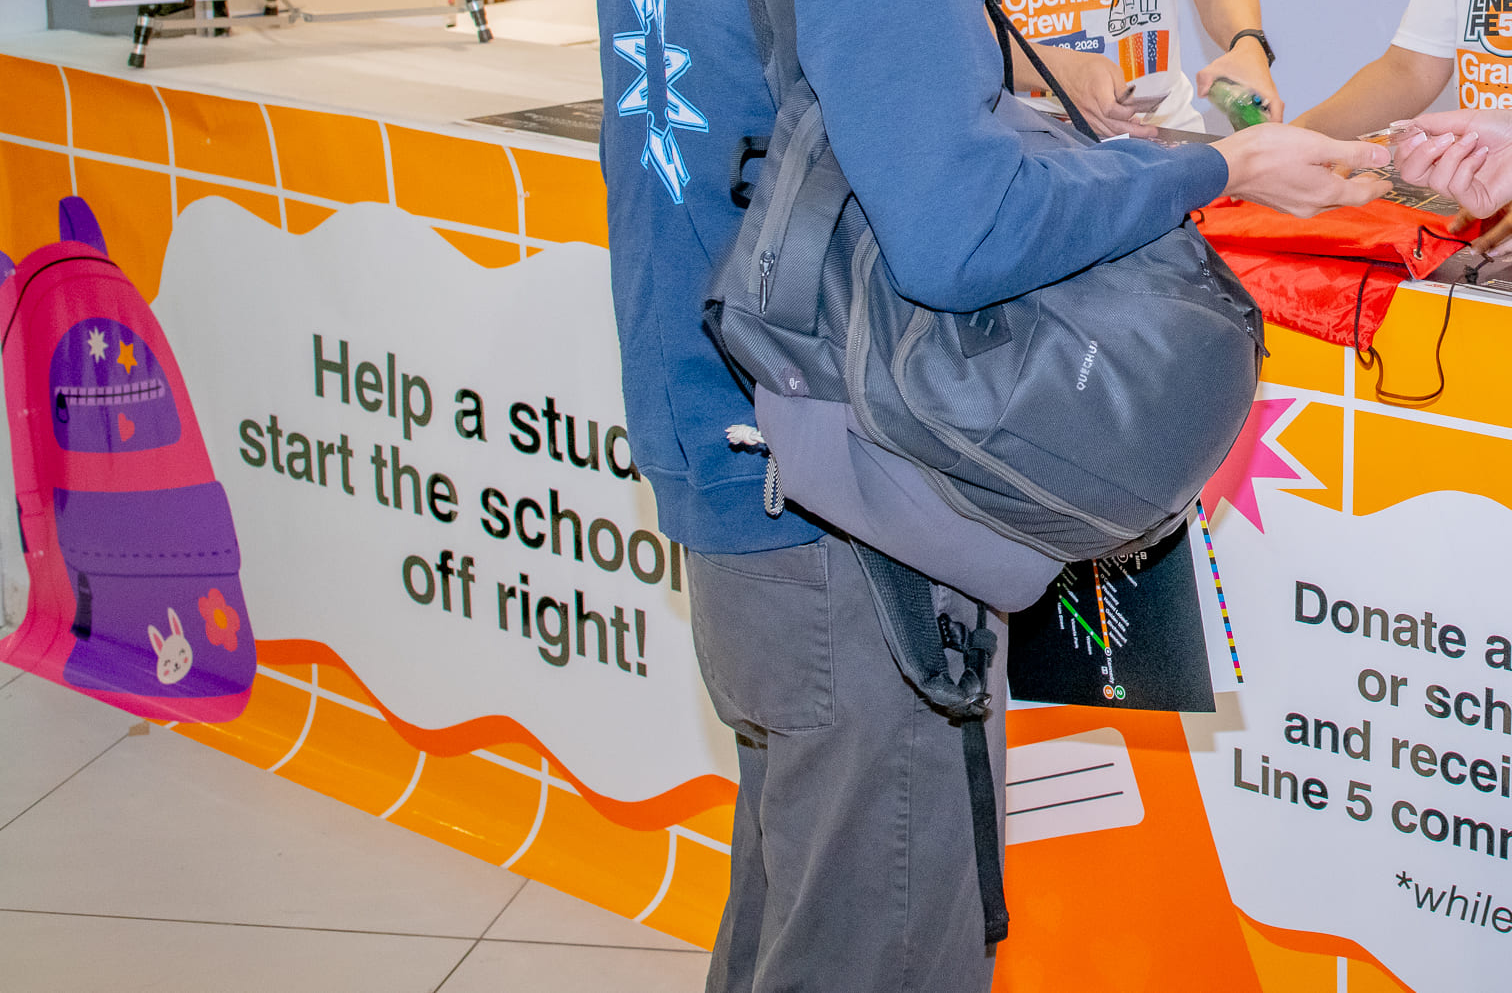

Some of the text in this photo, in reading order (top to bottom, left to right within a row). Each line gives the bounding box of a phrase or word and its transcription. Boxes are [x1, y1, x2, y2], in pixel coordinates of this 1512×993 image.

[1009, 10, 1075, 37] Crew
[1074, 39, 1099, 51] 2026
[313, 333, 432, 441] Help
[454, 387, 488, 443] a
[1076, 340, 1098, 391] QUECHUA
[239, 413, 683, 593] start the school
[401, 549, 648, 678] off right!
[1294, 580, 1468, 659] Donate
[1357, 667, 1408, 707] or
[1284, 710, 1372, 762] and
[1232, 747, 1329, 810] Line
[1345, 779, 1374, 823] 5
